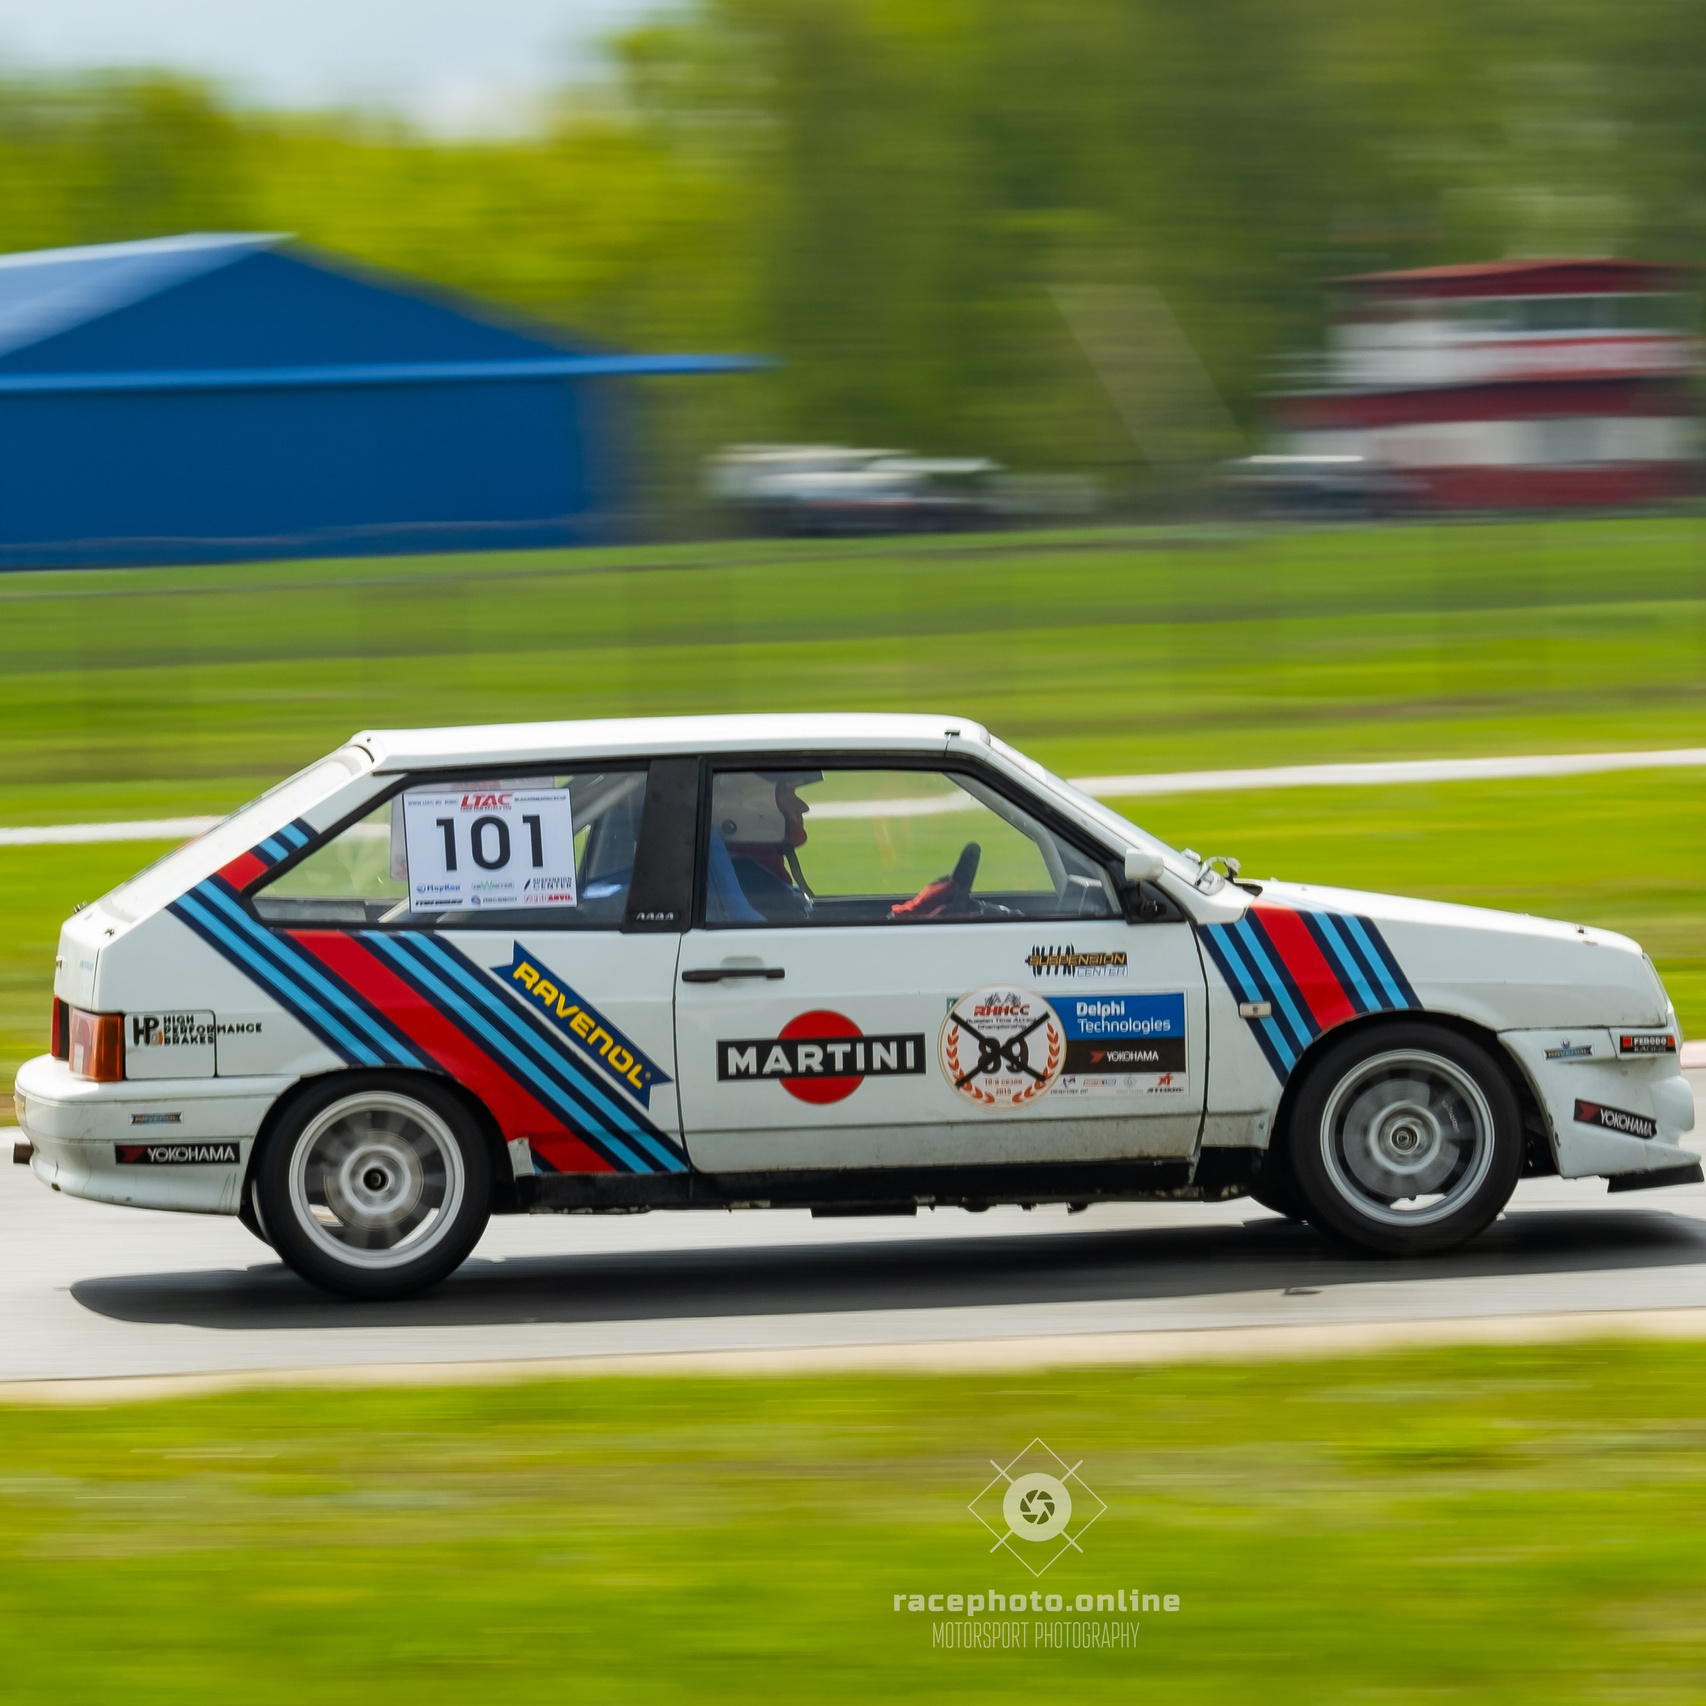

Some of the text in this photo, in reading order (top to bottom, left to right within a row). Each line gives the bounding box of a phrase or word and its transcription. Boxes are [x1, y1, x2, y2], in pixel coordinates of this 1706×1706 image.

[460, 793, 515, 808] LTAC
[436, 814, 544, 872] 101
[533, 883, 572, 891] CENTER
[1029, 953, 1126, 967] SUSPENSION
[1077, 966, 1126, 978] CENTER
[1076, 1000, 1125, 1019] Delphi
[163, 1015, 194, 1024] HIGH
[512, 961, 643, 1090] RAVENOL
[1077, 1017, 1171, 1035] Technologies
[163, 1023, 263, 1034] PERFORMANCE
[163, 1034, 215, 1045] BRAKES
[1633, 1036, 1667, 1045] FERODO
[728, 1040, 915, 1076] MARTINI
[1106, 1050, 1159, 1062] YOKOHAMA
[1600, 1108, 1653, 1137] YOKOHAMA
[147, 1146, 236, 1163] YOKOHAMA
